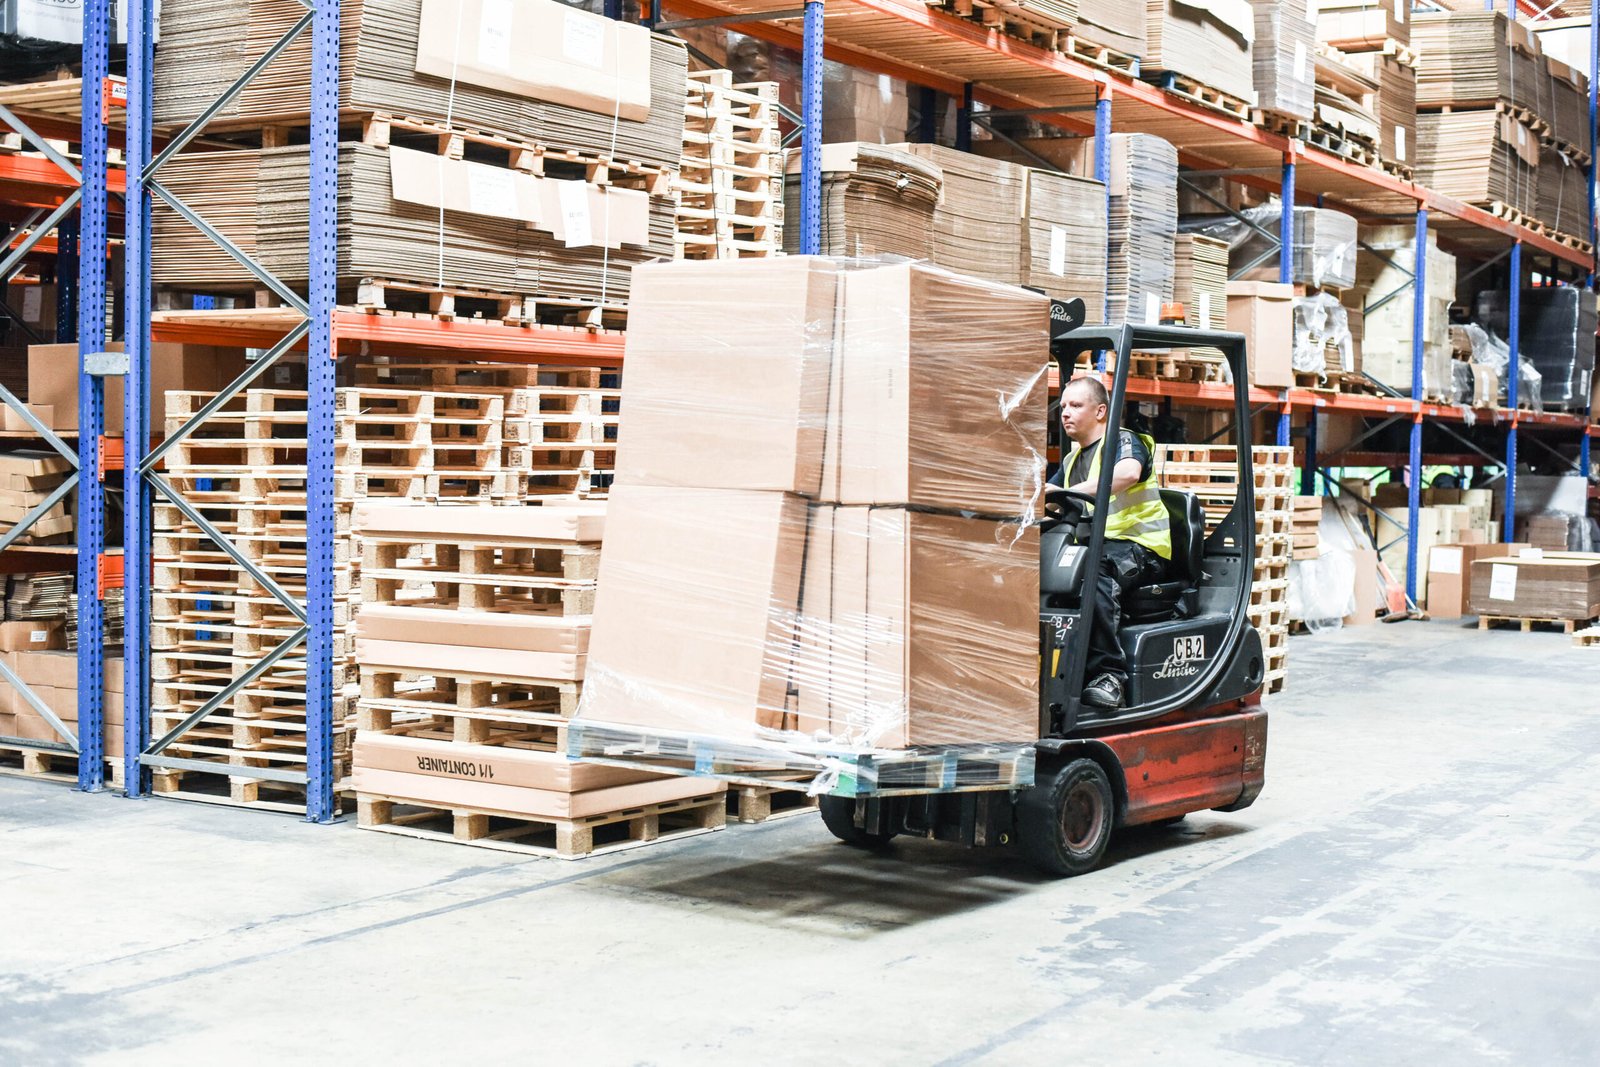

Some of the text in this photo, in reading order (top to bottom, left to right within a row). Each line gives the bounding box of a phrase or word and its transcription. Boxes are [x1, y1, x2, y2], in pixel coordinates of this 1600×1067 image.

[1152, 653, 1200, 679] Linde
[416, 756, 494, 778] 1/1 CONTAINER
